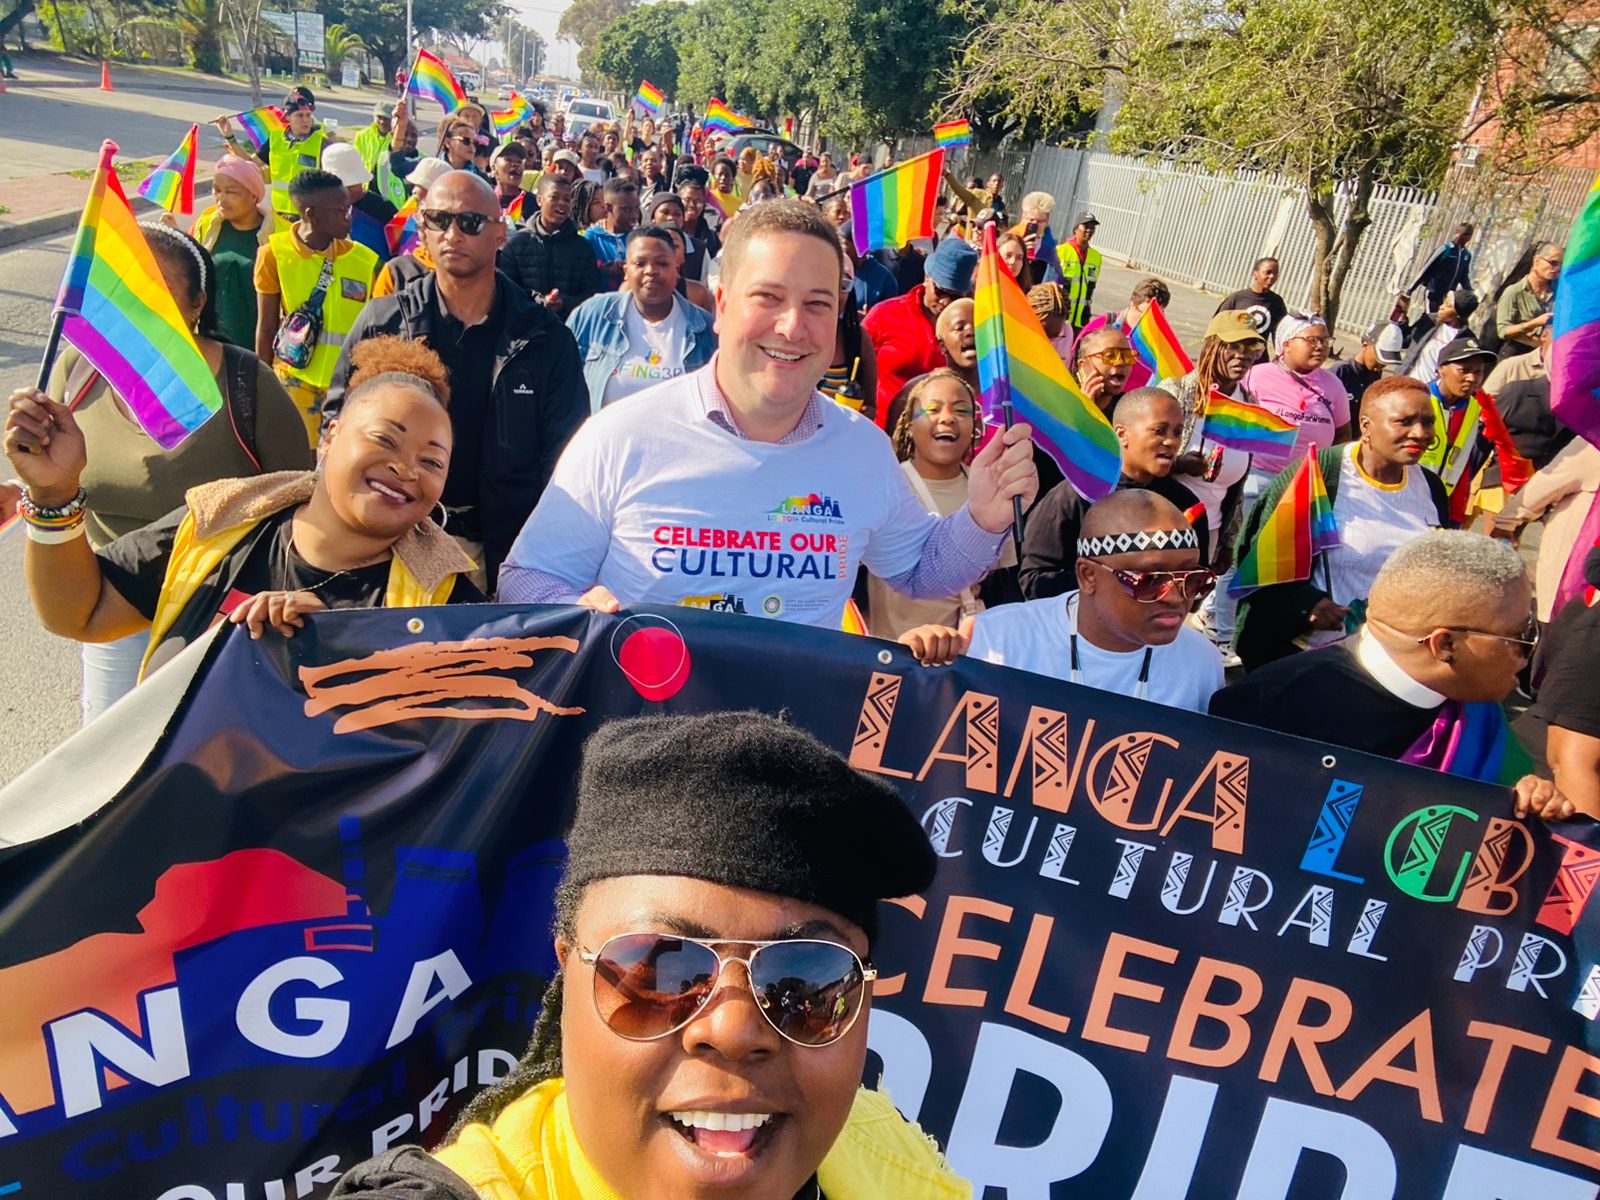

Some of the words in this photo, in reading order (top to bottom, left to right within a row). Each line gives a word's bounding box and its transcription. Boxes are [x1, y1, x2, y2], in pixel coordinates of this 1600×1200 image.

[781, 504, 833, 517] LANGA
[801, 516, 828, 524] Cultural
[653, 525, 782, 551] CELEBRATE
[790, 533, 837, 552] OUR
[838, 534, 848, 580] PRIDE
[651, 547, 836, 580] CULTURAL
[848, 671, 1250, 855] LANGA
[919, 796, 1388, 962] CULTURAL
[0, 948, 473, 1138] NGA
[60, 1056, 407, 1182] Cultural
